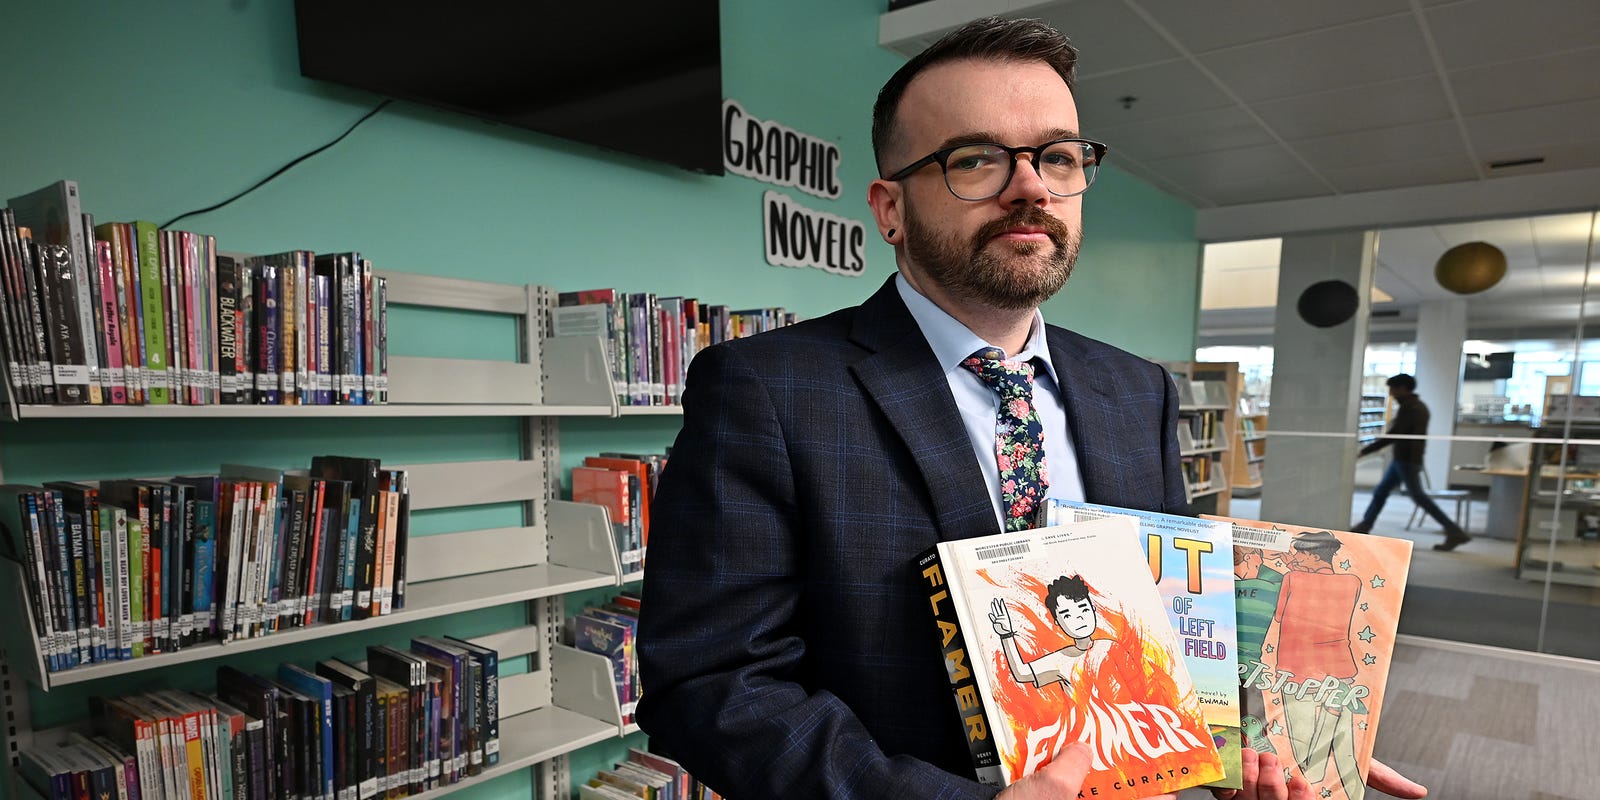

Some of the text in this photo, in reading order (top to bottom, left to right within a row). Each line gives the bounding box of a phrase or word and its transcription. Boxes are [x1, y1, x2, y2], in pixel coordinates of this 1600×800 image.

[724, 104, 839, 195] GRAPHIC
[770, 200, 864, 272] NOVELS
[59, 322, 69, 339] AYA
[104, 301, 117, 346] Batter Royale
[219, 296, 235, 358] BLACKWATER
[152, 353, 160, 363] 4
[292, 510, 303, 531] OVER
[70, 523, 83, 557] BATMAN
[290, 532, 300, 545] MY
[118, 560, 127, 575] BEAST
[286, 546, 298, 570] DEAD
[919, 554, 936, 566] CURATO
[1147, 534, 1214, 594] UT
[120, 587, 128, 603] LOVES
[1173, 596, 1192, 615] OF
[121, 603, 129, 620] RAVEN
[1180, 616, 1215, 638] LEFT
[922, 564, 987, 743] FLAMER
[1184, 638, 1226, 660] FIELD
[1238, 660, 1370, 711] RTSTOPPER
[1198, 696, 1229, 706] EWMAN
[185, 715, 200, 740] MARVEL
[1077, 766, 1190, 799] KE CURATO
